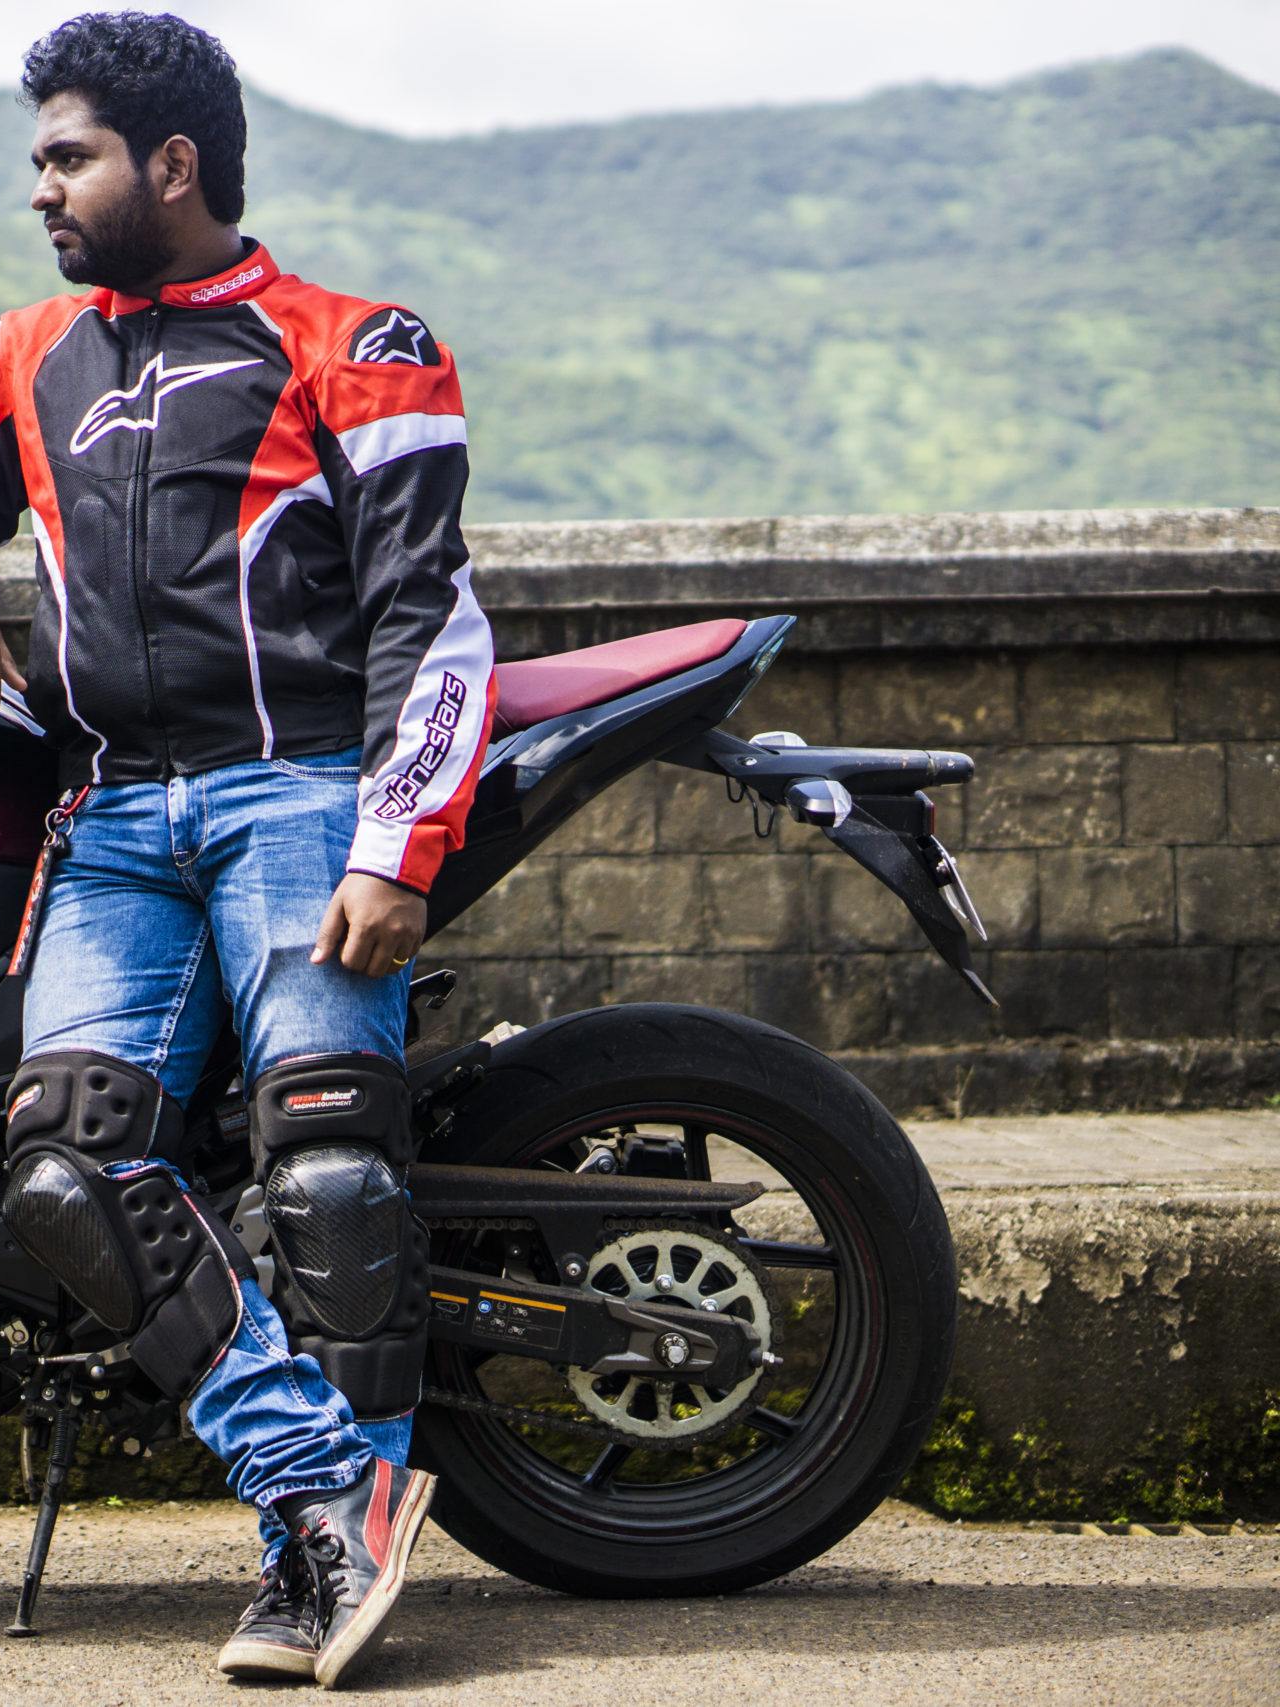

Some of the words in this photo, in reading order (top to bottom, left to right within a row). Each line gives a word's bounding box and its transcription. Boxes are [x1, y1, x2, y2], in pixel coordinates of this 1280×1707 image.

[191, 265, 263, 302] alpinestars
[374, 670, 467, 819] alpnestars
[292, 1102, 316, 1110] RACING
[316, 1100, 353, 1108] EQUIPMENT
